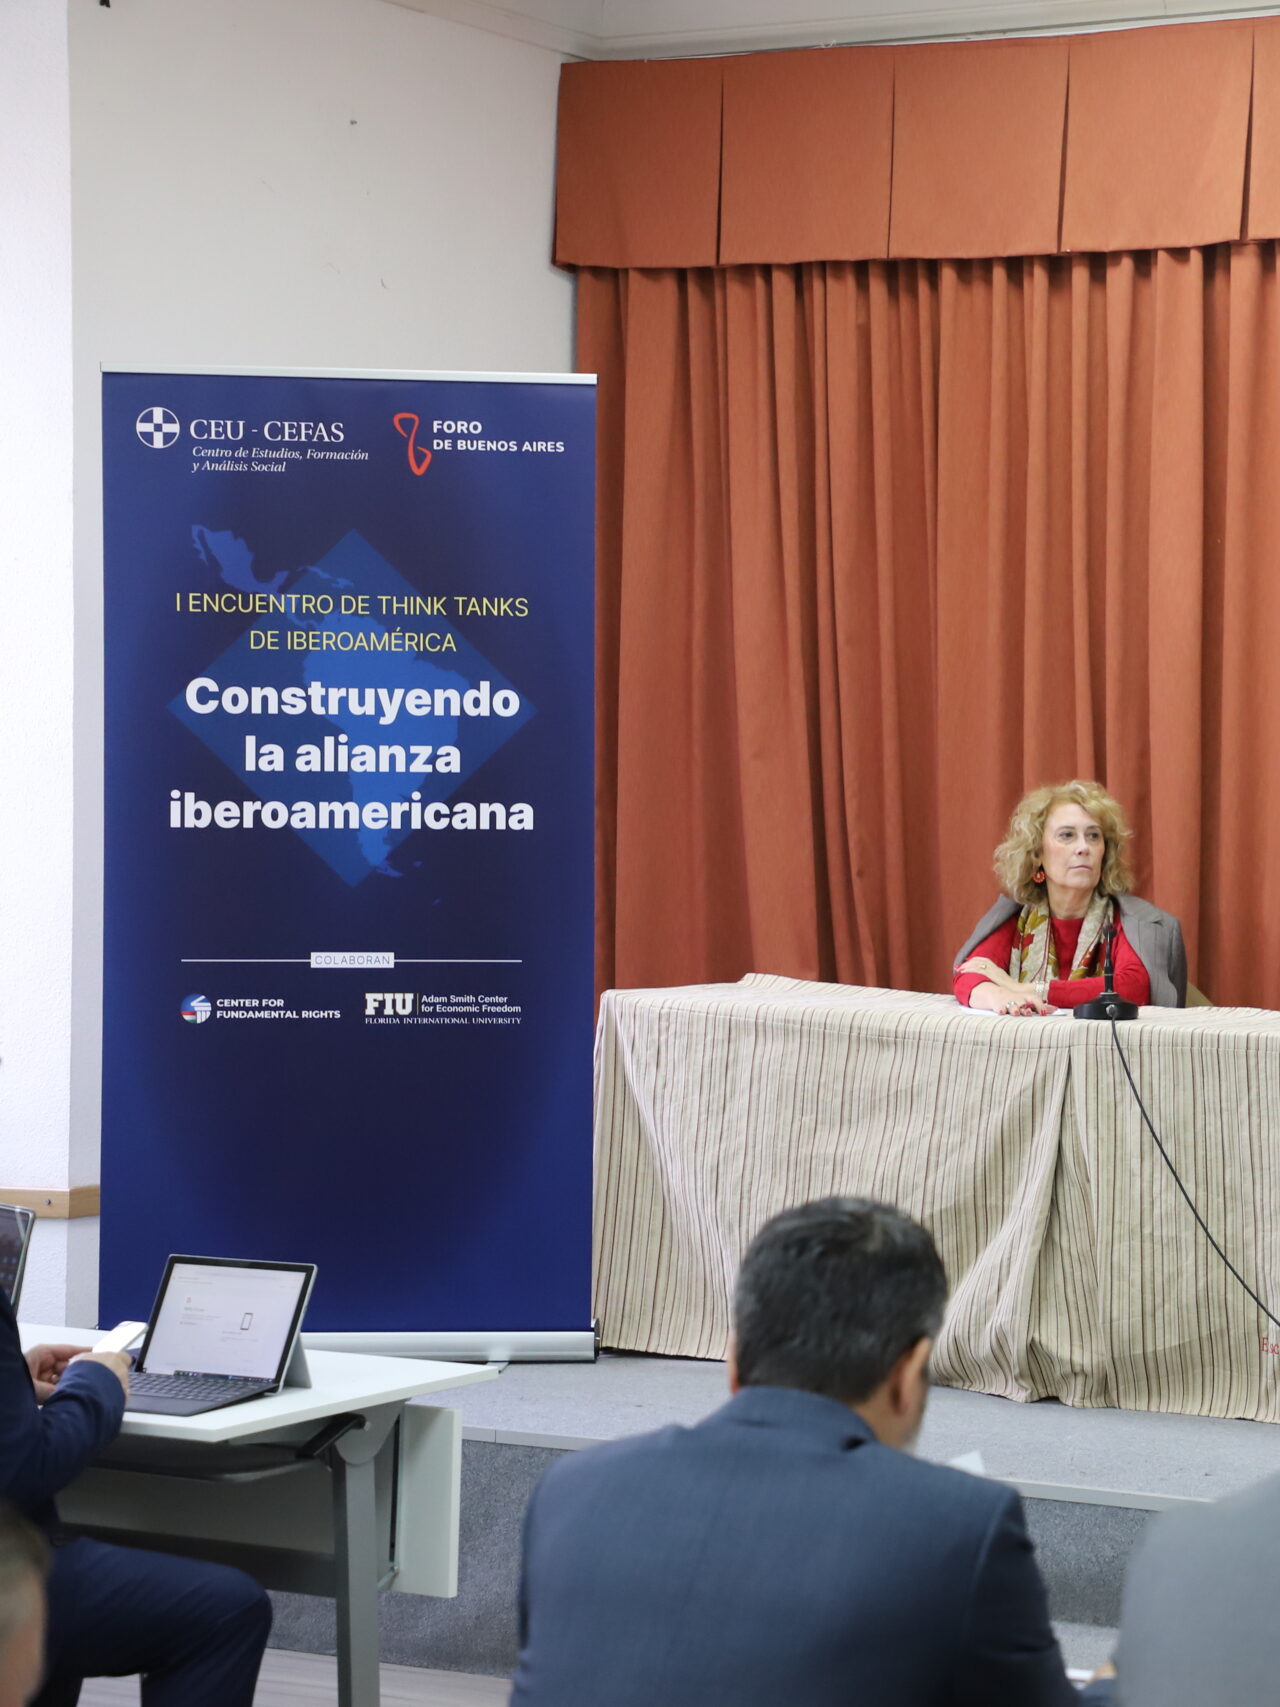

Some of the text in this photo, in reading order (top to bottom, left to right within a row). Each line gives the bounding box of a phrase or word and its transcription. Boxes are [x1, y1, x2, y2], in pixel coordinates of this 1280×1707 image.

[189, 418, 246, 441] CEU
[263, 420, 345, 443] CEFAS
[432, 420, 483, 435] FORO
[192, 446, 369, 461] Centro de Estudios, Formación
[432, 439, 565, 453] DE BUENOS AIRES
[191, 460, 287, 474] y Análisis Social
[188, 592, 334, 615] ENCUENTRO
[340, 594, 370, 615] DE
[376, 595, 447, 616] THINK
[453, 596, 529, 617] TANKS
[250, 626, 457, 653] DE IBEROAMÉRICA
[185, 677, 520, 725] Construyendo
[245, 733, 461, 774] la alianza
[169, 789, 534, 831] iberoamericana
[314, 955, 391, 965] COLABORAN
[216, 998, 285, 1008] CENTER FOR
[364, 992, 414, 1016] FIU
[421, 994, 508, 1004] Adam Smith Center
[216, 1009, 341, 1020] FUNDAMENTAL RIGHTS
[421, 1003, 522, 1014] for Economic Freedom
[365, 1017, 522, 1025] FLORIDA INTERNATIONAL UNIVERSITY
